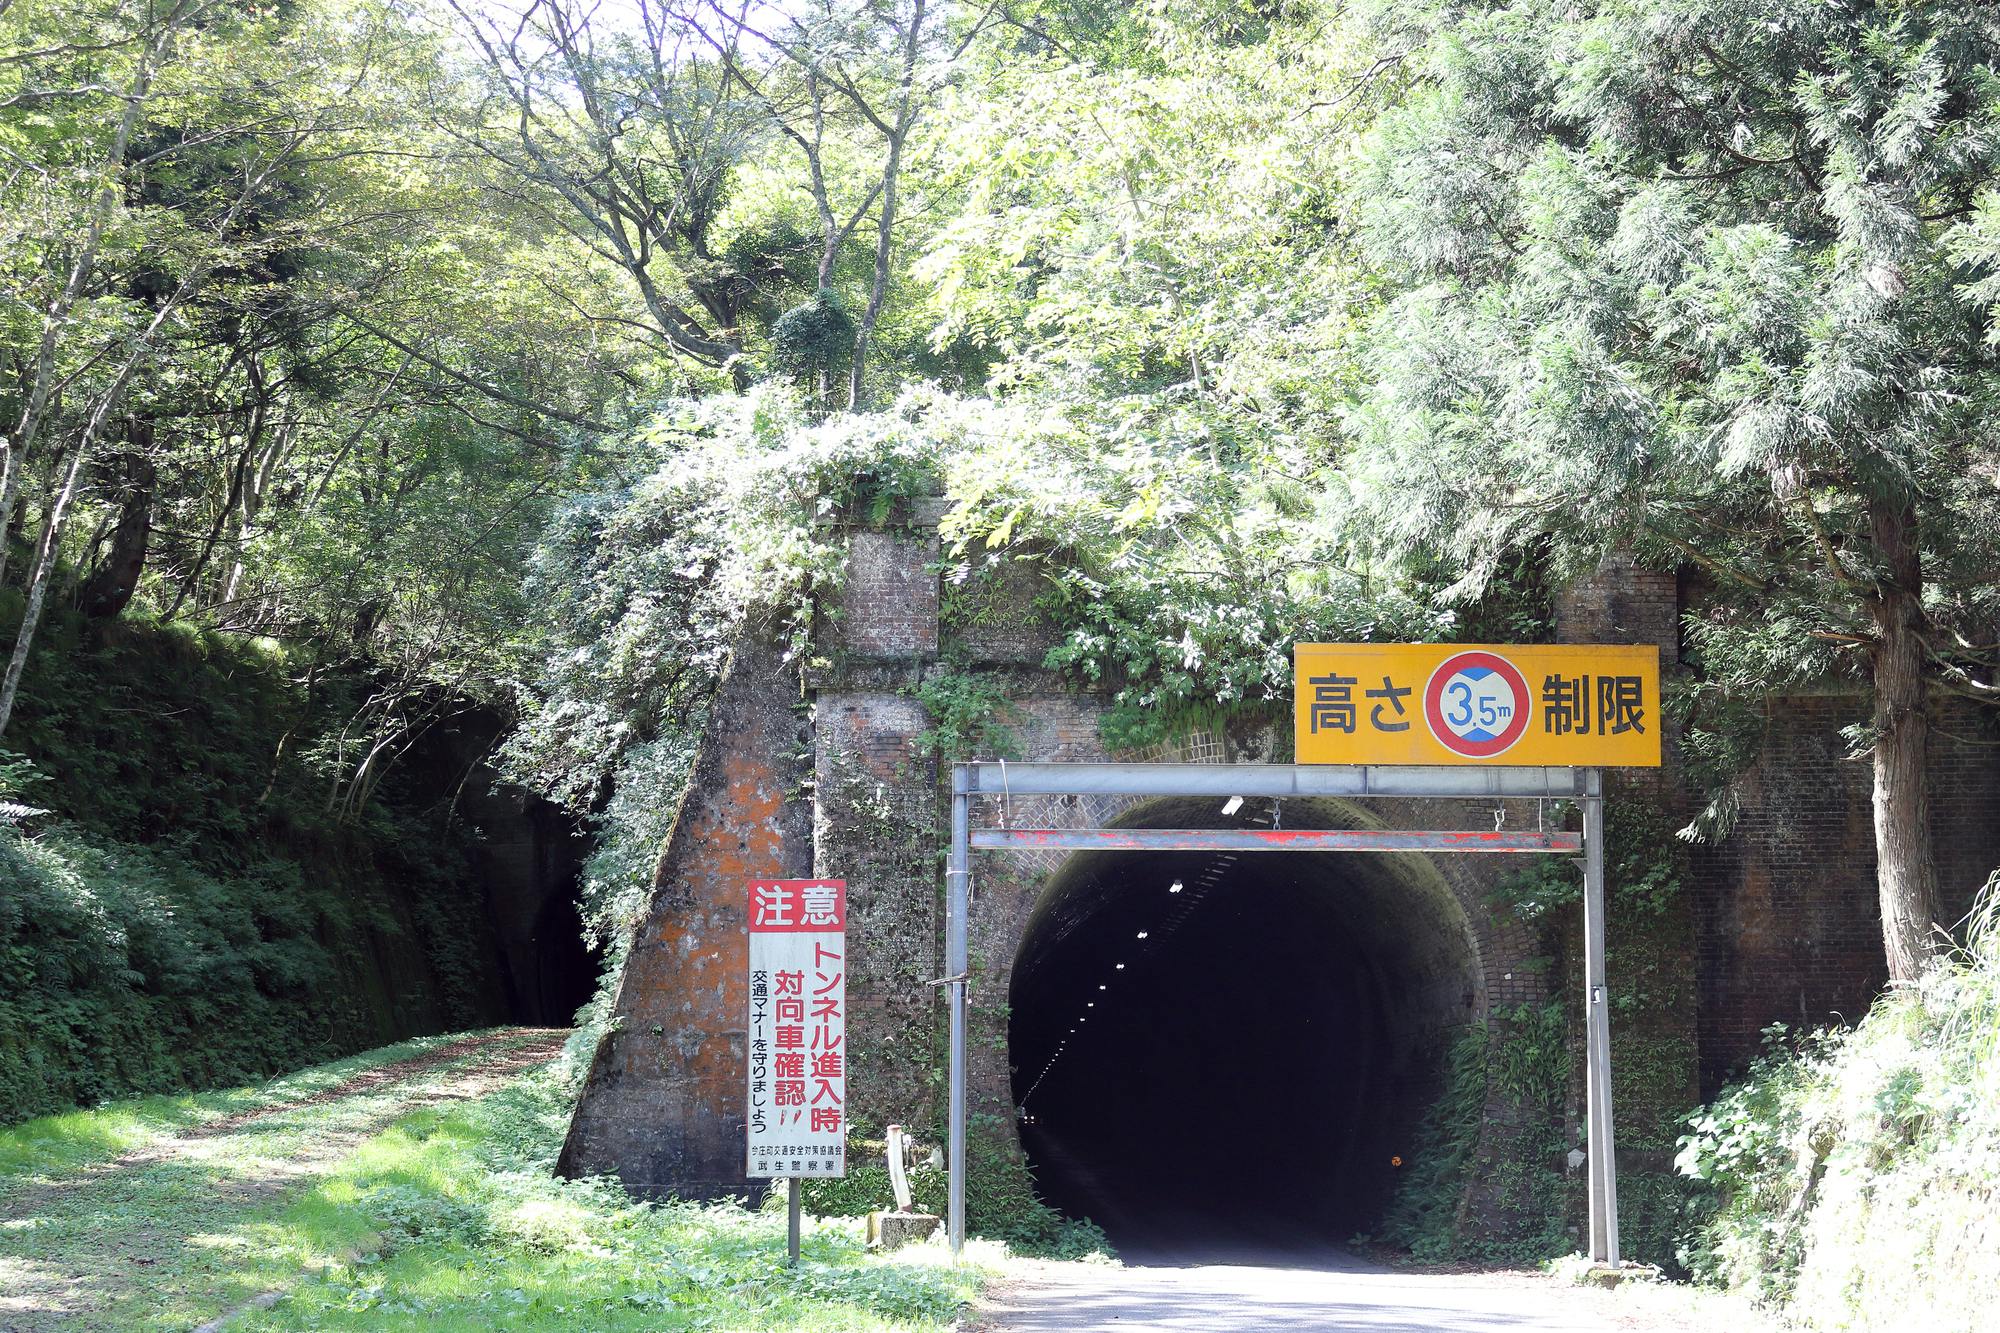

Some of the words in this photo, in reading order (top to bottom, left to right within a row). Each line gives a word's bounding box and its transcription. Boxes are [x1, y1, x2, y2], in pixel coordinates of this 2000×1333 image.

[1309, 673, 1412, 734] 高さ
[1448, 682, 1511, 727] 3.5m
[1542, 674, 1646, 736] 制限
[755, 884, 840, 926] 注意
[752, 970, 768, 1134] 交通マナーを守りましょう
[810, 941, 842, 1133] トンネル進入時
